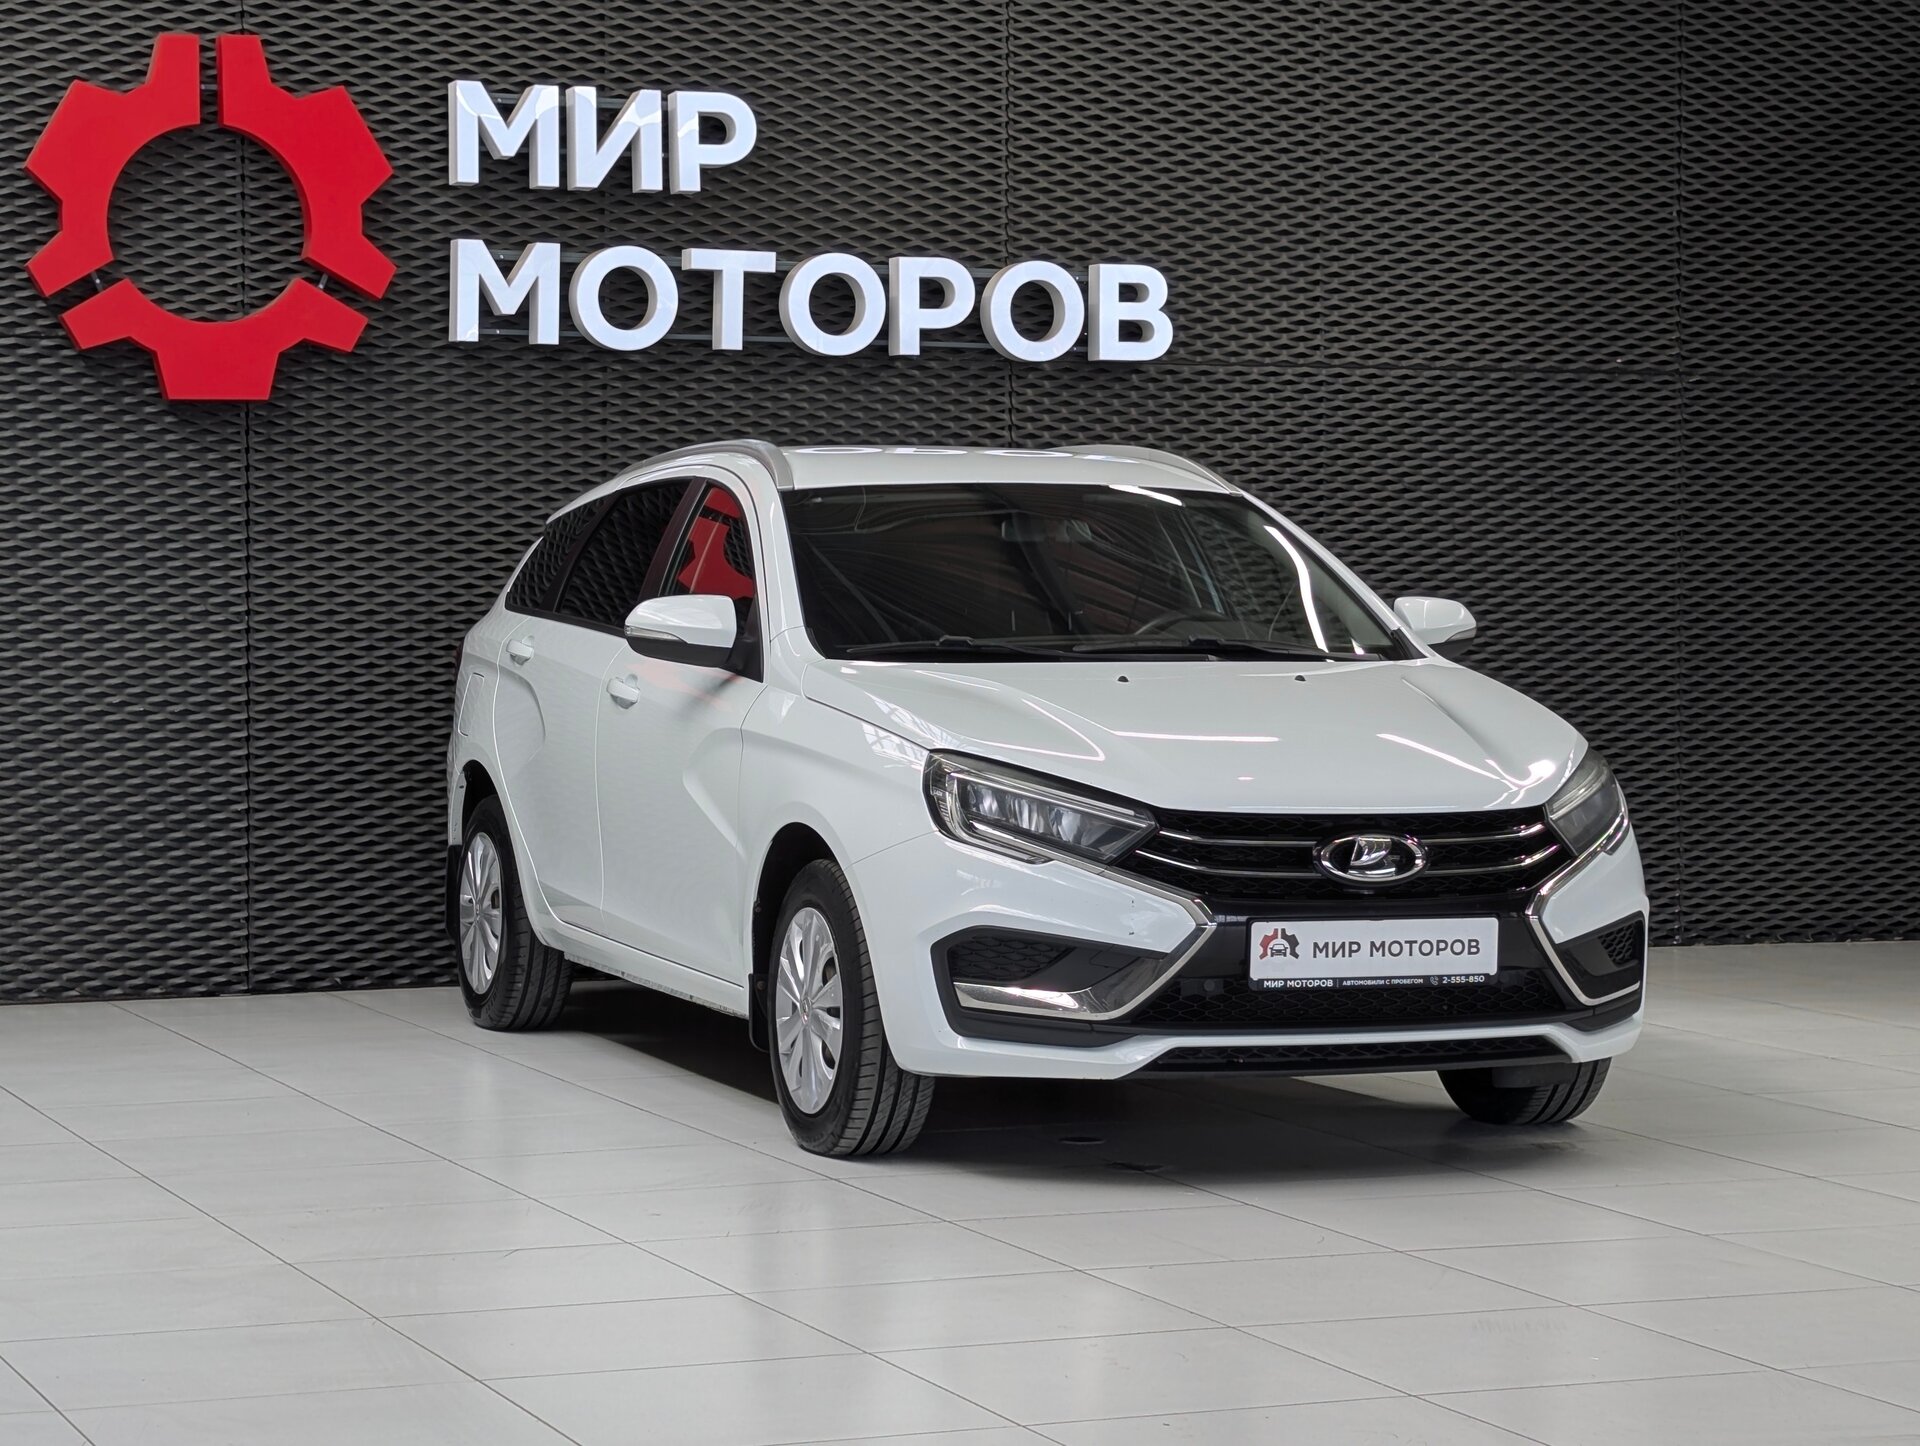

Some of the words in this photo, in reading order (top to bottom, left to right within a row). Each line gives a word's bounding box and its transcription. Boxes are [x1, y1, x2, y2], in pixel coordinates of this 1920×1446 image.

[448, 79, 757, 194] МИР
[449, 238, 1174, 362] МОТОРОВ
[1263, 980, 1285, 988] МИР
[1286, 979, 1334, 988] МОТОРОВ
[1442, 975, 1485, 984] 2-555-850
[1312, 941, 1362, 959] МИР
[1369, 938, 1481, 958] МОТОРОВ
